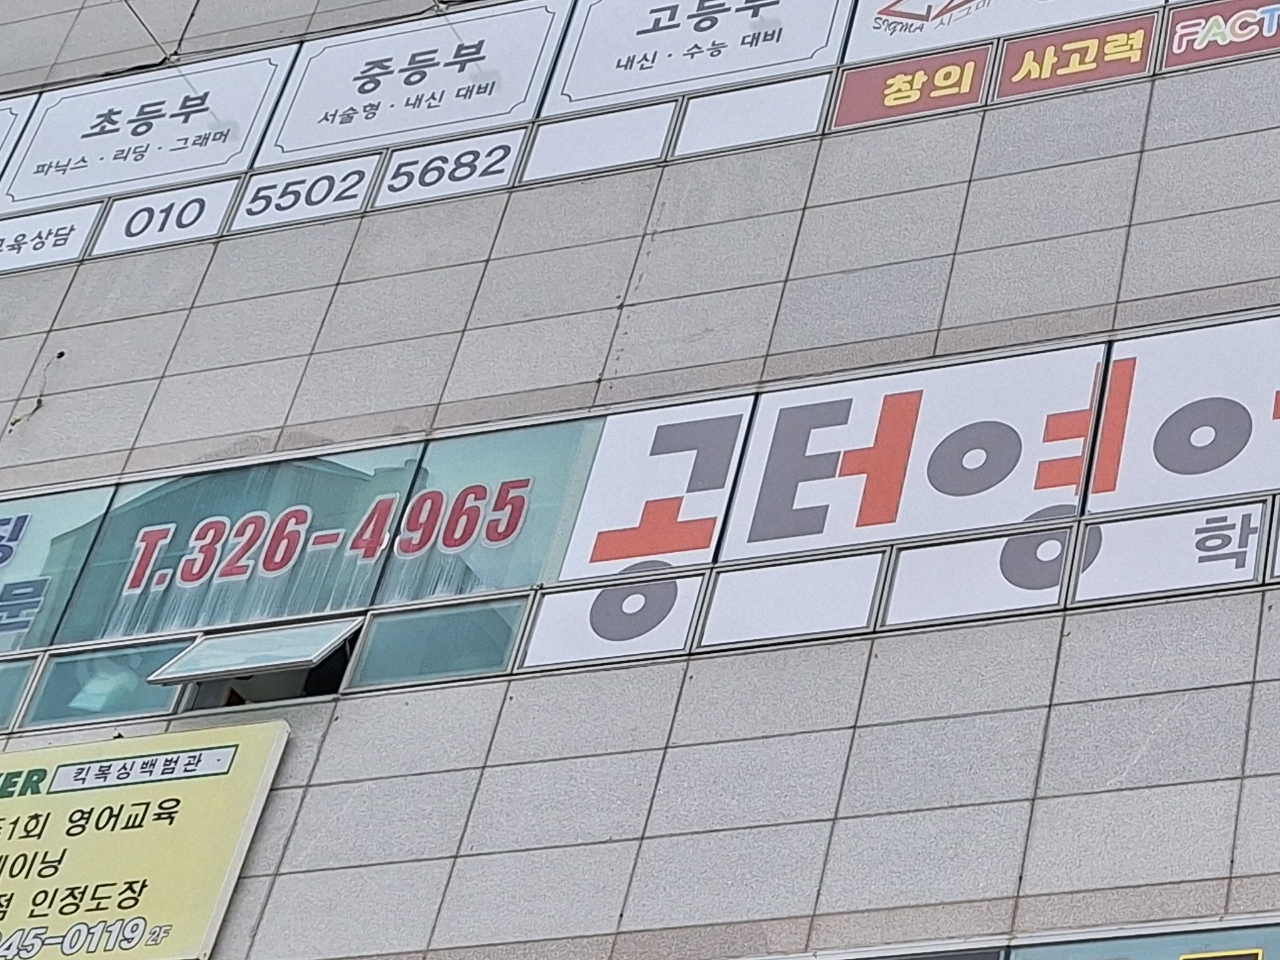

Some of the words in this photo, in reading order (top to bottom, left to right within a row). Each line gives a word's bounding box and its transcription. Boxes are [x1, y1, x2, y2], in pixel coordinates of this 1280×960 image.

[615, 50, 658, 71] 내신
[682, 40, 729, 58] 수능
[740, 27, 783, 48] 대비
[872, 17, 925, 36] SIGMA
[352, 39, 487, 95] 중등부
[883, 61, 976, 107] 창의
[1010, 29, 1146, 83] 사고력
[80, 91, 210, 140] 초등부
[317, 101, 381, 125] 서술형
[404, 89, 446, 110] 내신
[454, 80, 497, 101] 대비
[32, 156, 89, 176] 파닉스
[112, 143, 150, 162] 리딩
[169, 128, 231, 152] 그래머
[124, 197, 206, 238] 010
[245, 169, 366, 217] 5502
[386, 144, 512, 193] 5682
[122, 477, 534, 595] T.326-4965
[0, 767, 49, 800] ER
[0, 811, 52, 842] 1회
[65, 797, 182, 837] 영어교육
[27, 878, 149, 919] 인정도장
[0, 916, 148, 960] 45-0119
